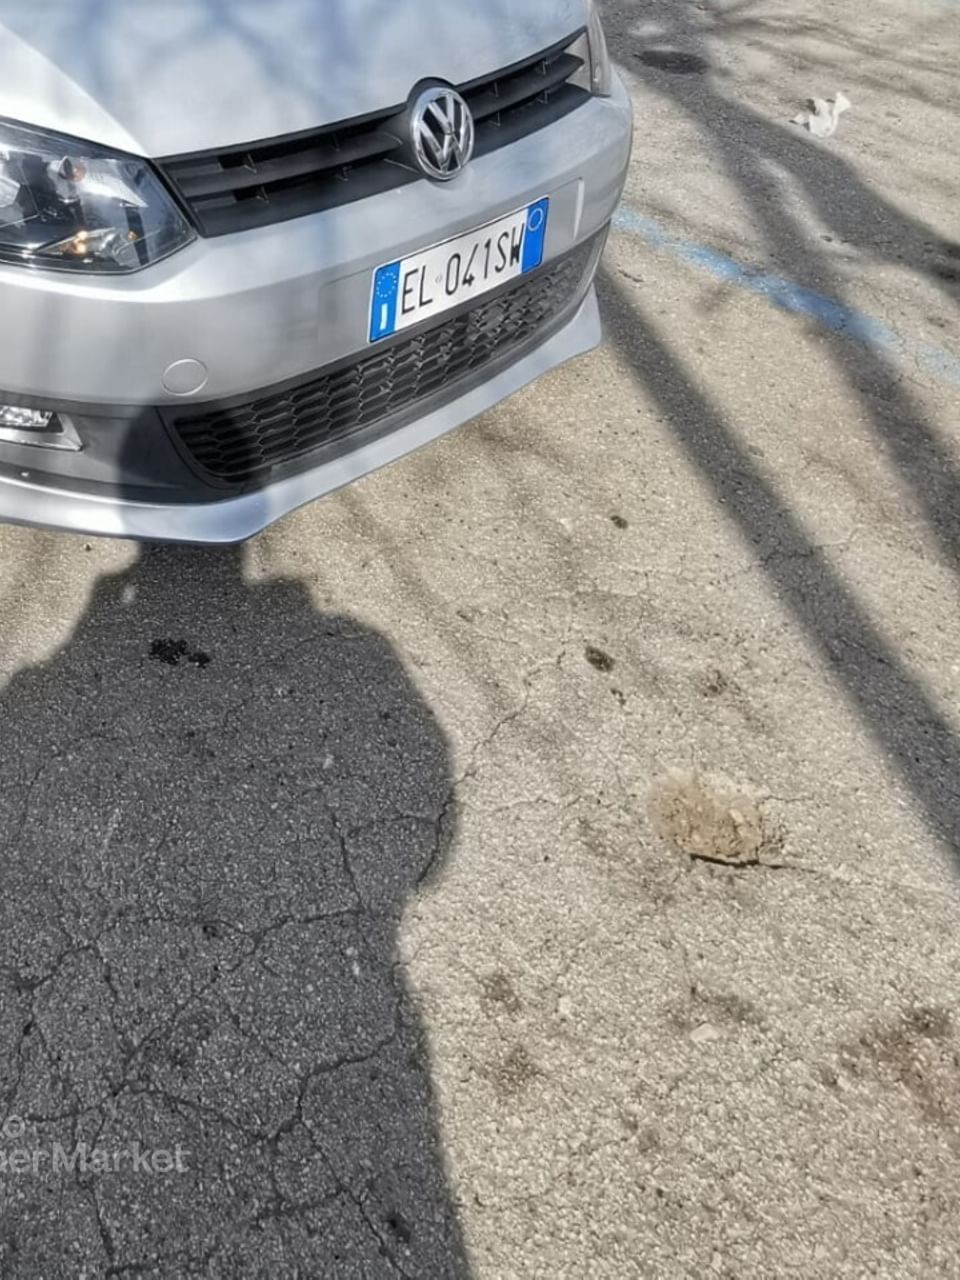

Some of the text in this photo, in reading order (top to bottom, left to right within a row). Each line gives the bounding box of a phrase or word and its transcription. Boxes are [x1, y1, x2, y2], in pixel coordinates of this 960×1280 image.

[412, 88, 473, 178] VW
[401, 222, 525, 315] EL 041SW
[379, 302, 389, 331] I
